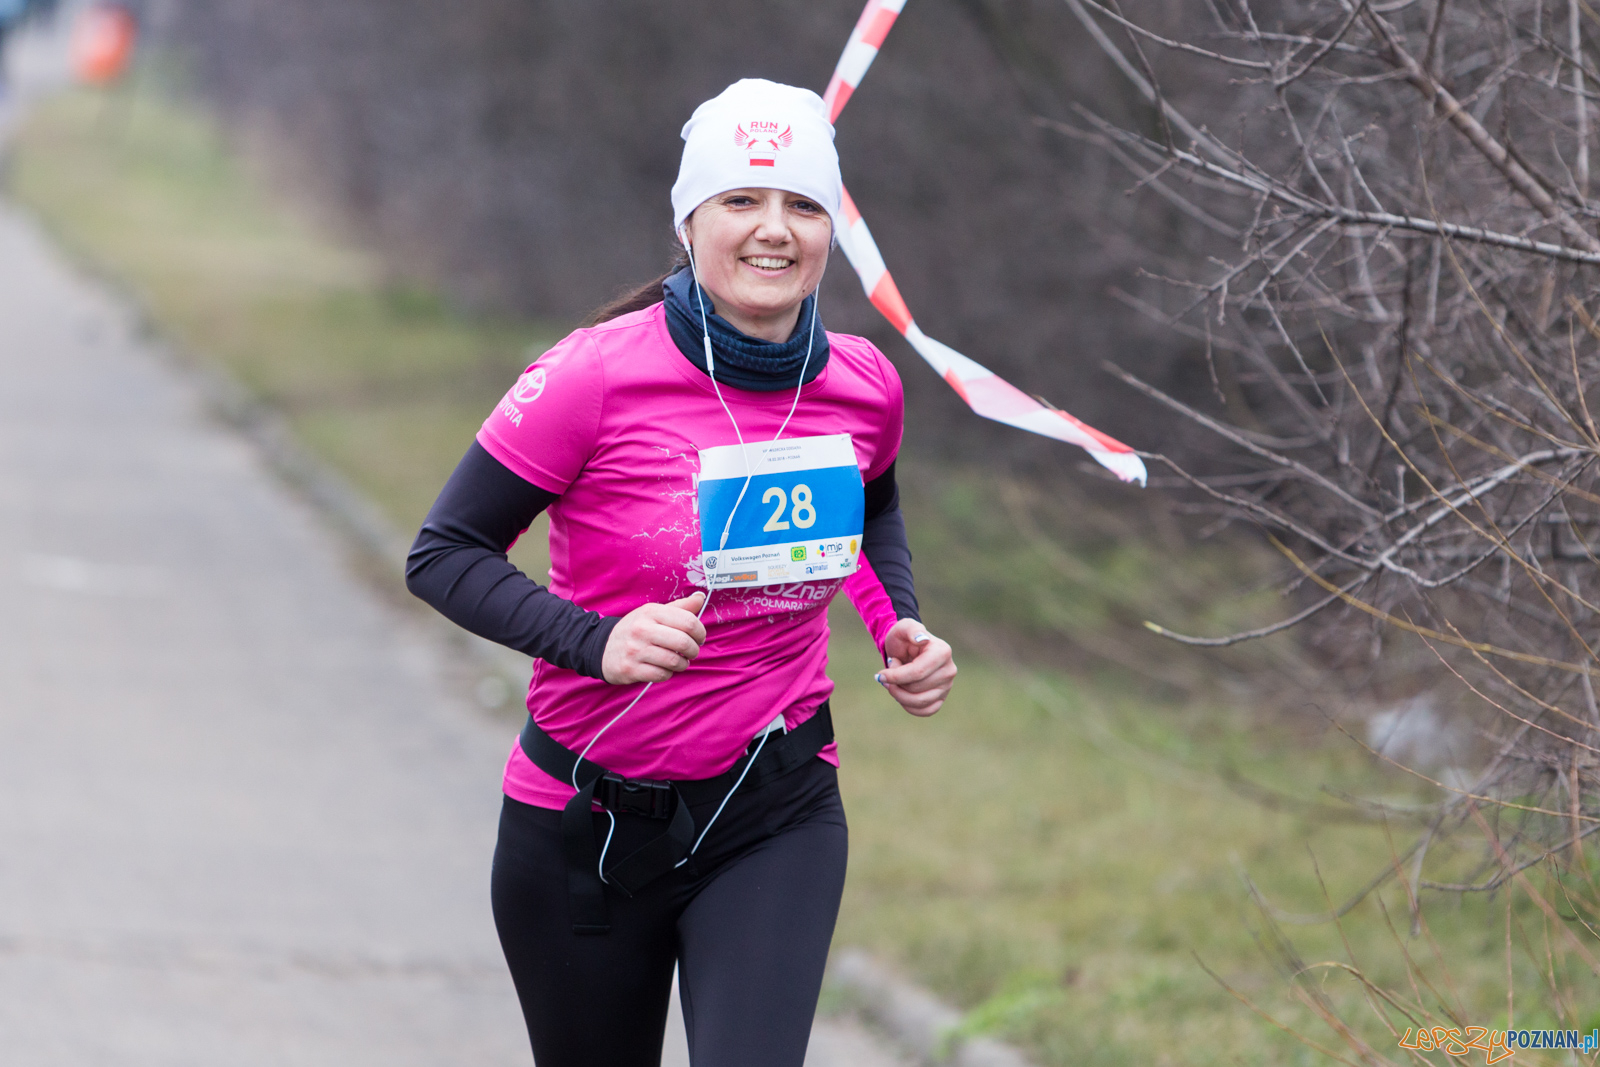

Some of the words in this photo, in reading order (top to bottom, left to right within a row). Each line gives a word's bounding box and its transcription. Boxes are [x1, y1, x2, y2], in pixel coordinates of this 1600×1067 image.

[750, 121, 778, 129] RUN
[499, 395, 523, 428] OYOTA
[762, 483, 816, 532] 28
[827, 542, 842, 553] mjp
[731, 554, 761, 562] Volkswagen
